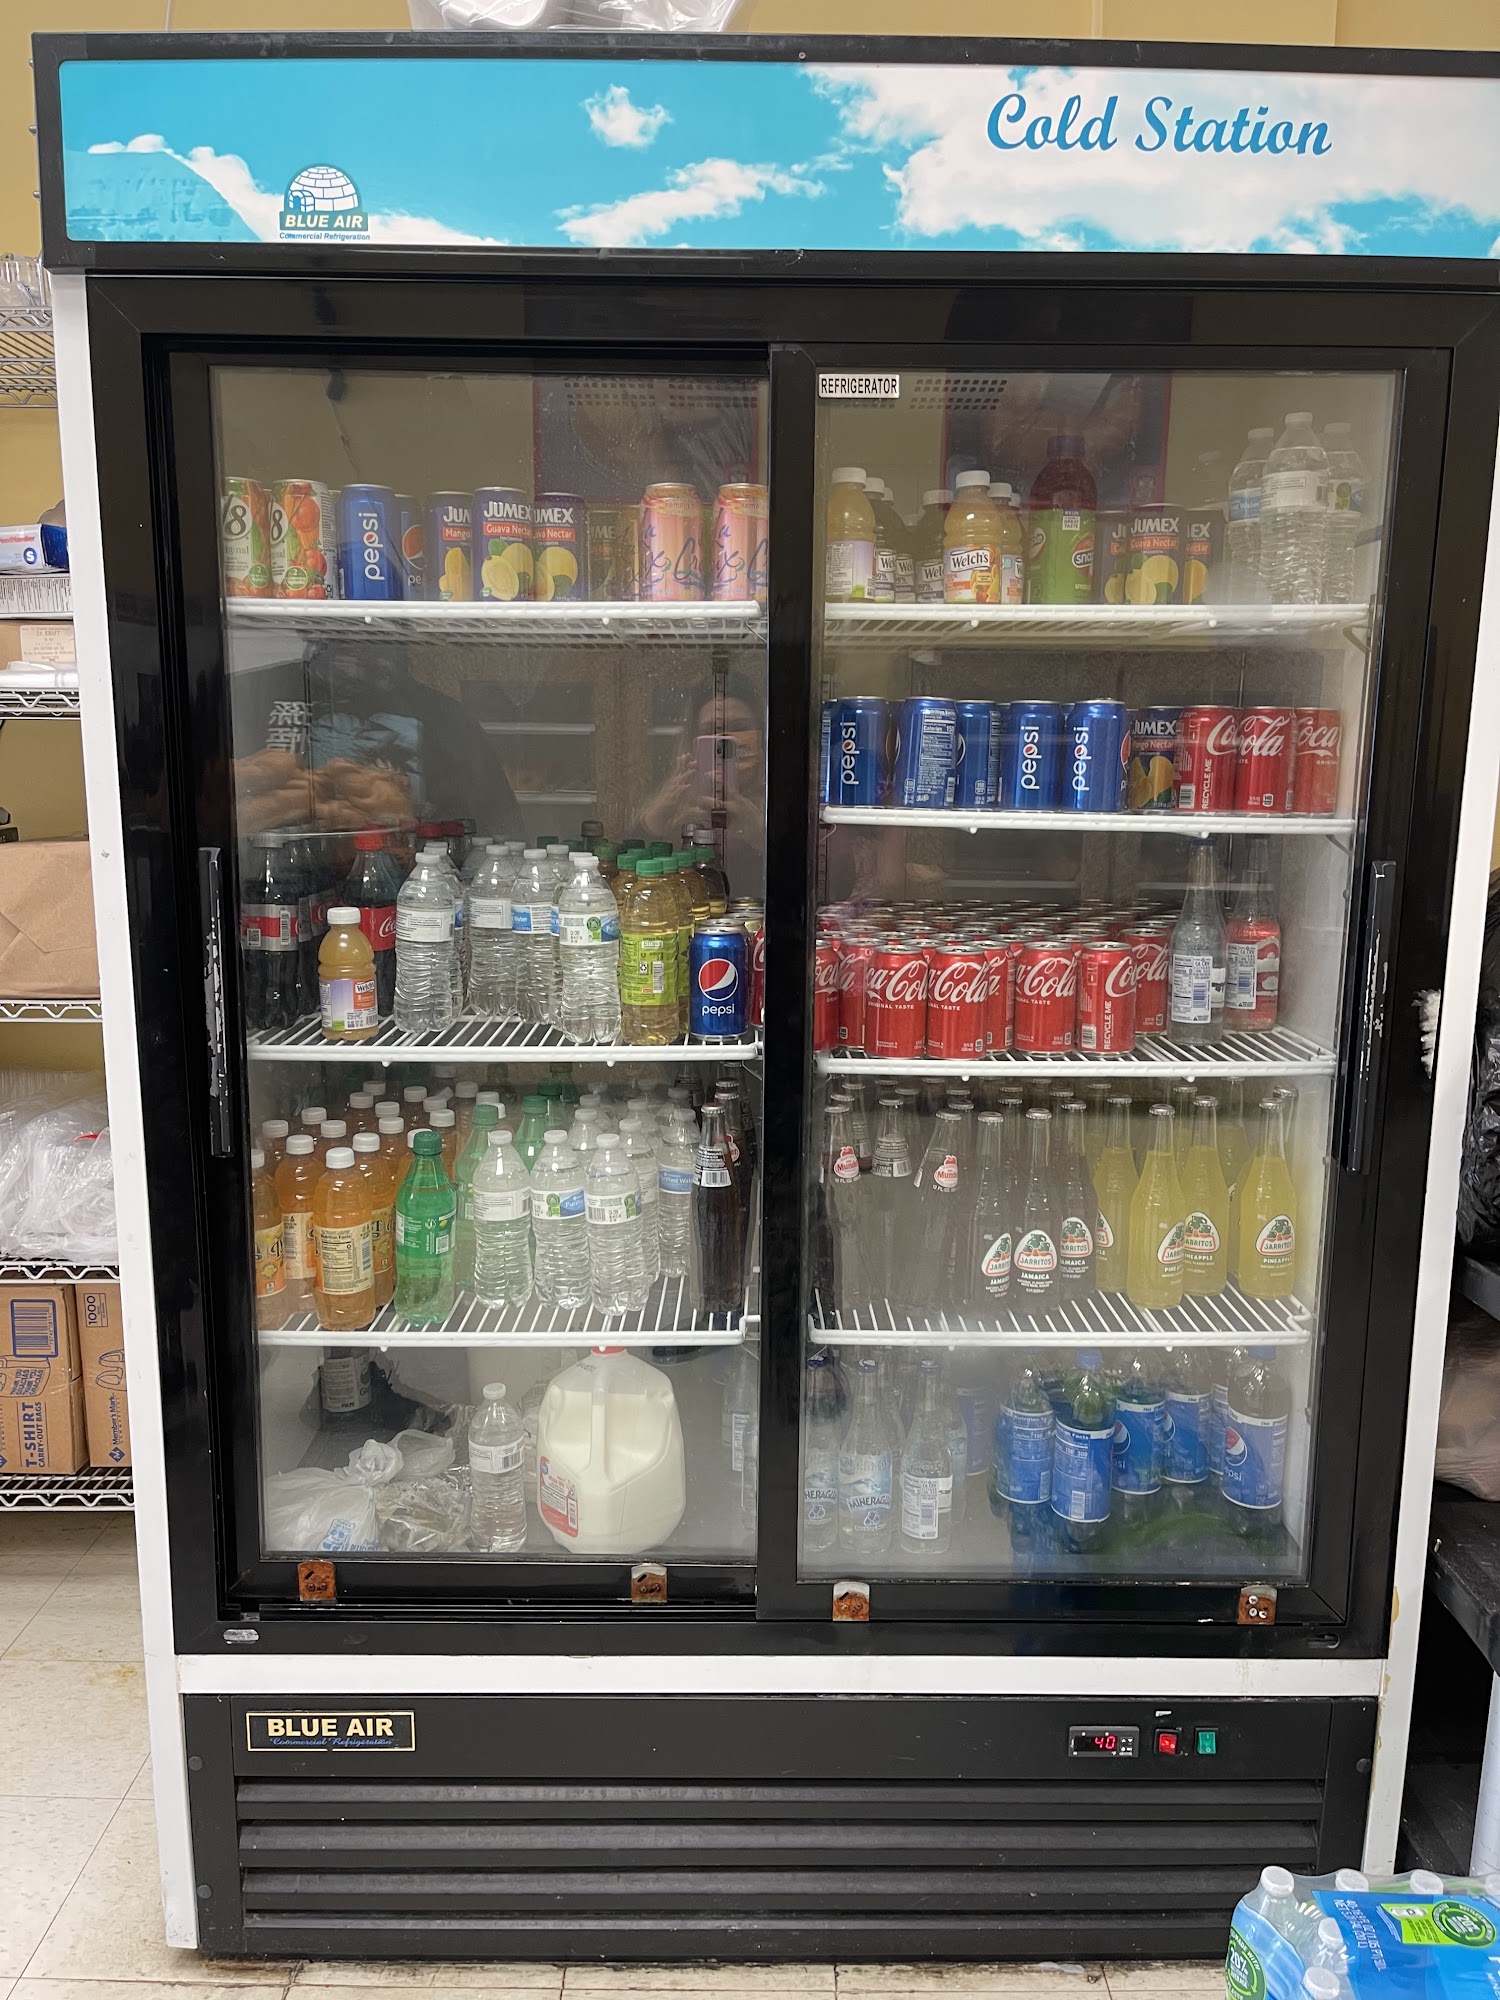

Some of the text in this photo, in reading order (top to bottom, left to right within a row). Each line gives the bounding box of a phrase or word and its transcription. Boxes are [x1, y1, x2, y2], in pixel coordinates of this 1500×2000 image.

[986, 93, 1333, 156] Cold Station
[285, 214, 363, 229] BLUE AIR
[279, 232, 371, 242] Commercial Refrigeration
[821, 378, 898, 394] REFRIGERATOR
[484, 500, 531, 523] JUMEX
[486, 523, 511, 534] Guava
[1131, 517, 1180, 533] JUMEX
[546, 529, 573, 540] Nectar
[1130, 538, 1152, 549] Guava
[1152, 537, 1178, 549] Nectar
[358, 512, 385, 581] pepsi
[952, 552, 990, 569] Welch's
[1132, 719, 1177, 736] JUMEX
[840, 721, 861, 785] pepsi
[1150, 740, 1174, 750] Nectar
[1020, 725, 1042, 790] pepsi
[1072, 726, 1092, 792] pepsi
[1202, 758, 1212, 810] RECYCLE ME
[702, 1003, 735, 1017] pepsi
[868, 1000, 893, 1010] ORIGINAL
[1103, 1000, 1112, 1050] RECYCLE ME
[1020, 1256, 1052, 1267] JARRITOS
[1263, 1257, 1292, 1265] PINEAPPLE
[1021, 1271, 1050, 1280] JAMAICA
[87, 1295, 98, 1326] 1000
[108, 1394, 120, 1445] Member's Mark
[22, 1402, 37, 1468] T-SHIRT
[35, 1401, 46, 1468] CARRY-OUT BAGS
[267, 1718, 394, 1737] BLUE AIR
[269, 1737, 393, 1748] Commercial Refrigeration
[1094, 1735, 1117, 1751] 40
[1230, 1946, 1249, 1975] 20%
[1247, 1951, 1261, 1971] WITH
